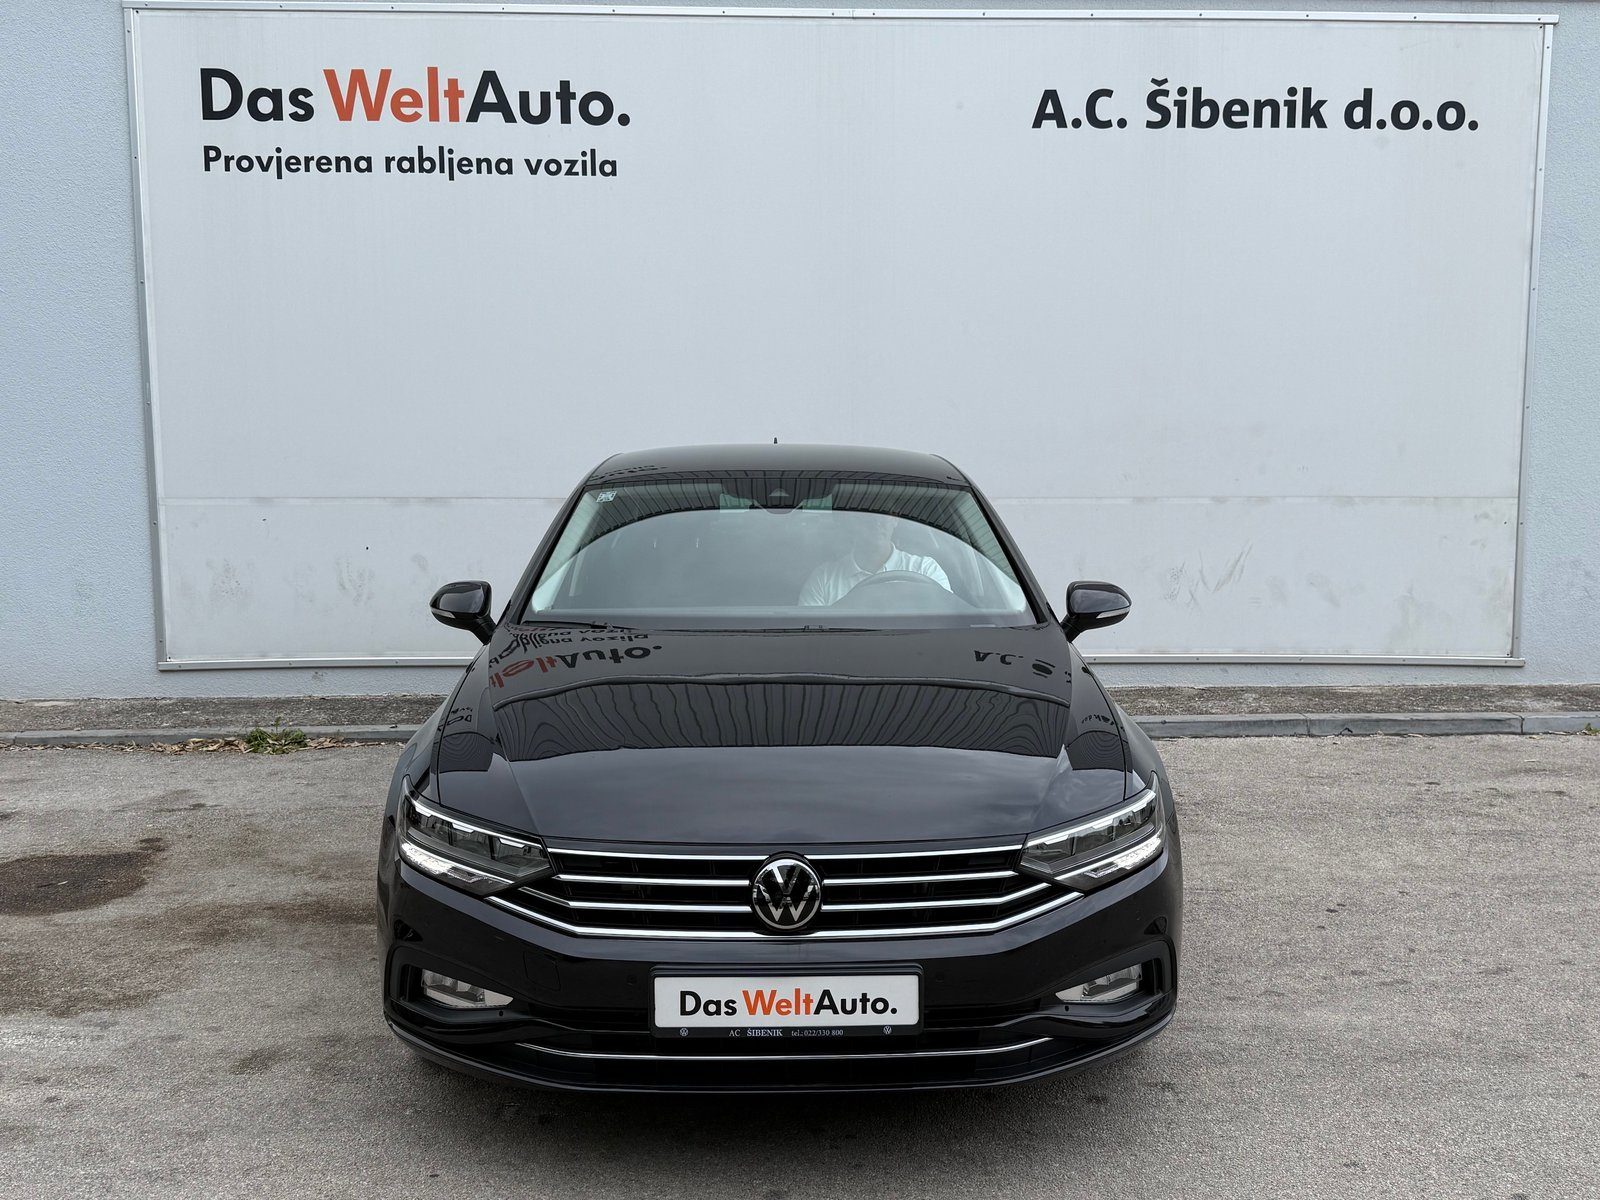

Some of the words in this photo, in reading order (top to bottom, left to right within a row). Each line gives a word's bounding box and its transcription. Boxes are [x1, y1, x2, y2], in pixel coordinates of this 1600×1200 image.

[200, 67, 314, 122] Das
[323, 66, 631, 127] WeltAuto.
[1031, 88, 1128, 130] A.C.
[1145, 78, 1328, 130] Šibenik
[1343, 87, 1479, 131] d.o.o.
[203, 144, 373, 180] Provjerena
[384, 145, 514, 182] rabljena
[524, 148, 618, 178] vozila
[679, 990, 738, 1017] Das
[742, 987, 898, 1016] WeltAuto.
[728, 1029, 741, 1037] AC
